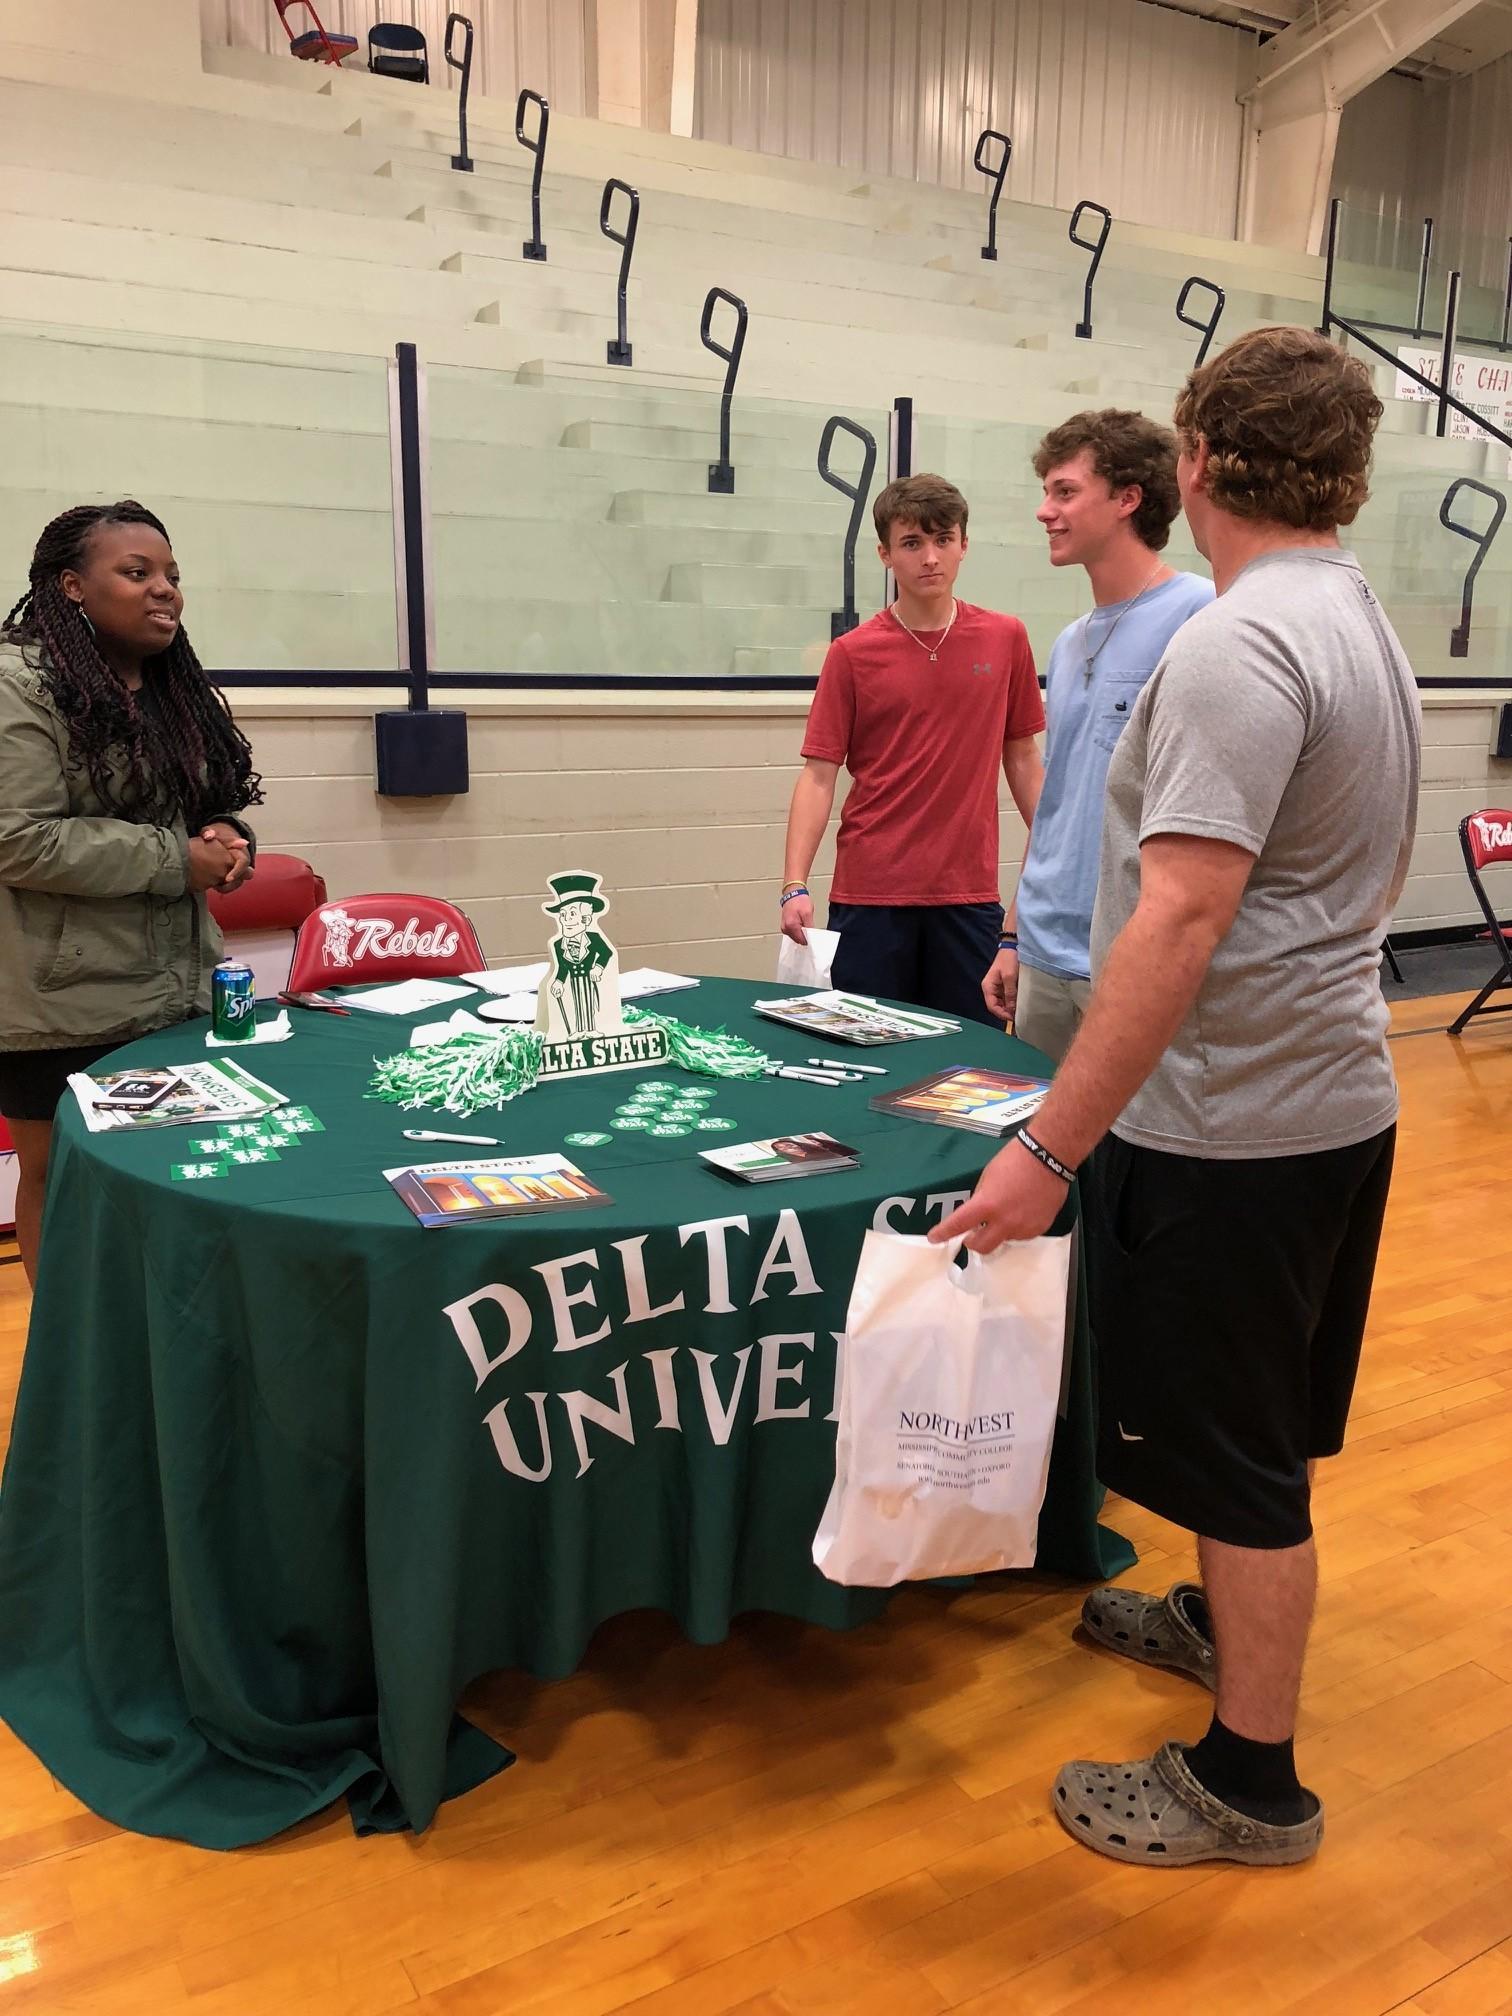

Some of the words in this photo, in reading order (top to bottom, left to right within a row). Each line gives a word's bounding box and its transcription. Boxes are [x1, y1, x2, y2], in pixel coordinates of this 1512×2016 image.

[1418, 357, 1465, 386] STE
[1477, 366, 1512, 392] CHA
[353, 917, 460, 960] Rebels
[541, 1042, 588, 1074] LTA
[591, 1032, 662, 1066] STATE
[420, 1163, 475, 1174] DELTA
[481, 1159, 536, 1169] STATE
[442, 1208, 824, 1393] DELTA
